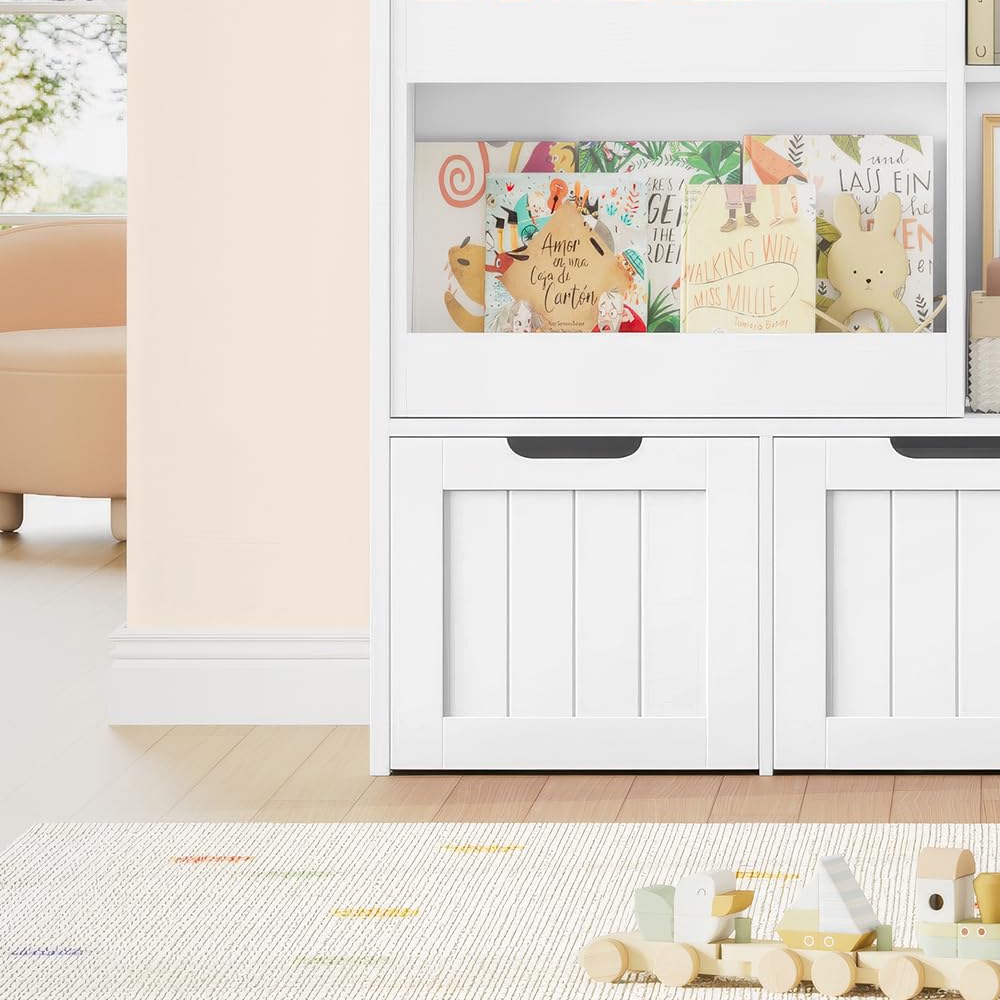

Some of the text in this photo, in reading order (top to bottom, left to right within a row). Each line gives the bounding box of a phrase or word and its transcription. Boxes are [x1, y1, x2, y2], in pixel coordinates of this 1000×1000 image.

[839, 168, 881, 194] LASS
[541, 231, 581, 257] Amor
[653, 228, 676, 242] THE
[683, 233, 800, 283] WALKING WITH
[544, 281, 599, 314] Cartón
[693, 286, 722, 308] MISS
